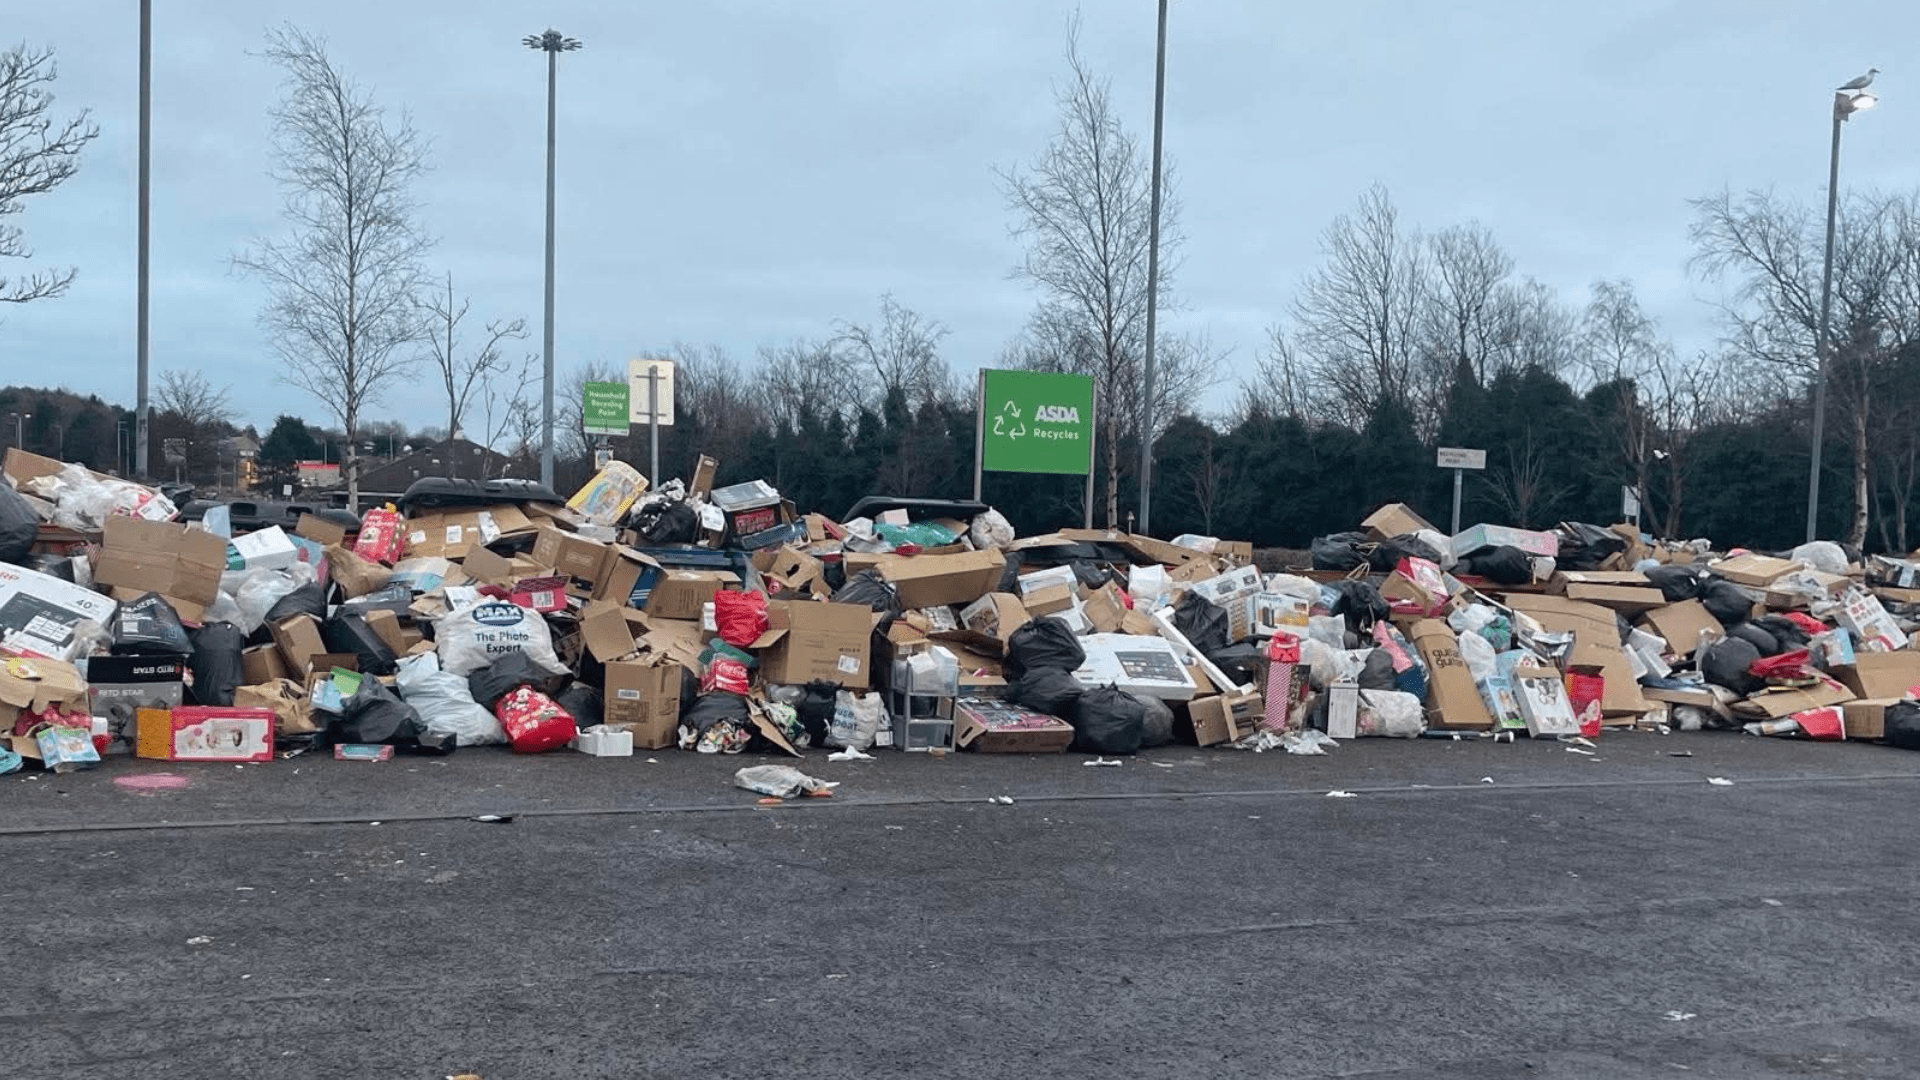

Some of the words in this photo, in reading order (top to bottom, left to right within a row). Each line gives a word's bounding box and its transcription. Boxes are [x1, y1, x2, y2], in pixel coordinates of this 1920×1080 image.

[589, 391, 626, 400] Household
[591, 399, 623, 410] Recycling
[598, 408, 616, 417] Point
[1034, 405, 1080, 423] ASDA
[1033, 428, 1079, 440] Recycles
[476, 606, 521, 618] MAX
[475, 632, 495, 642] The
[499, 630, 530, 641] Photo
[486, 643, 522, 654] Expert
